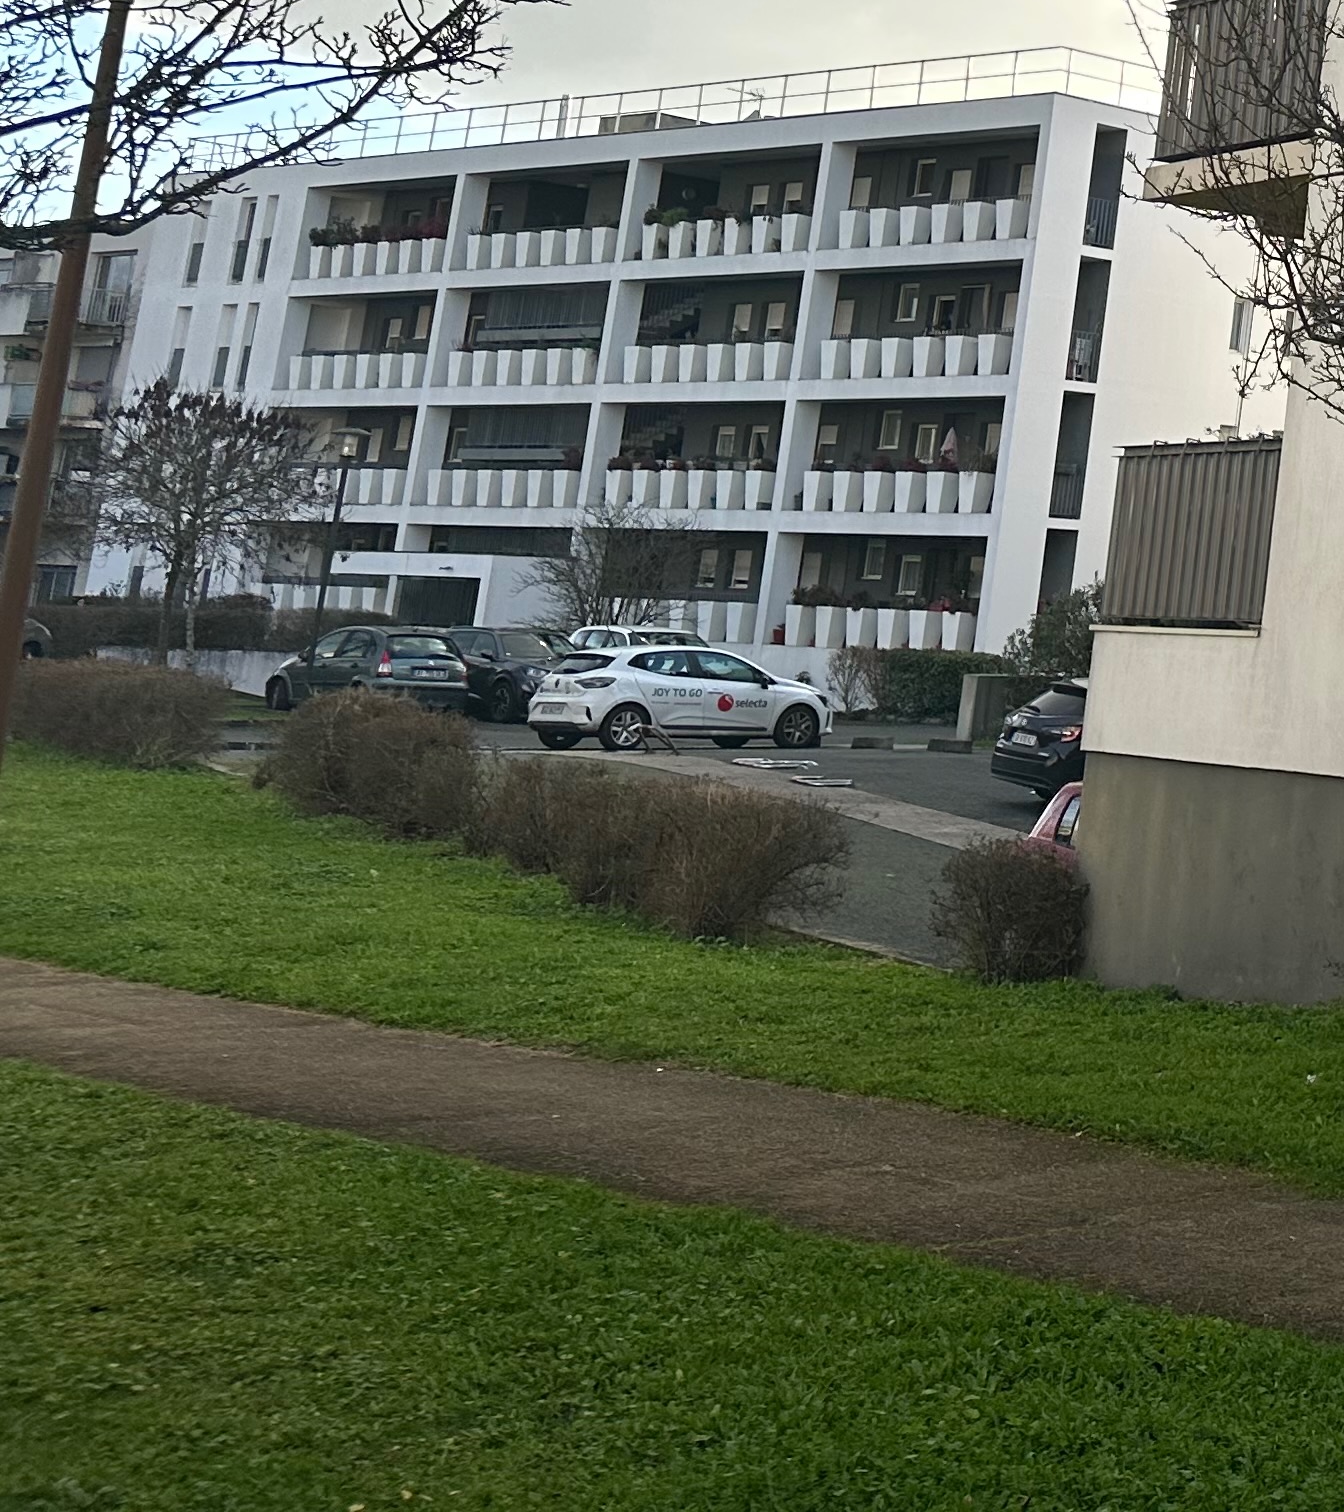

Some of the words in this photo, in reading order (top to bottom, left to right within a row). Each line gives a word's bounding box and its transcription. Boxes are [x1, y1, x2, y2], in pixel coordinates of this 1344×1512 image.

[651, 687, 670, 697] JOY
[672, 688, 687, 697] TO
[688, 688, 703, 697] GO
[735, 698, 767, 708] selecta
